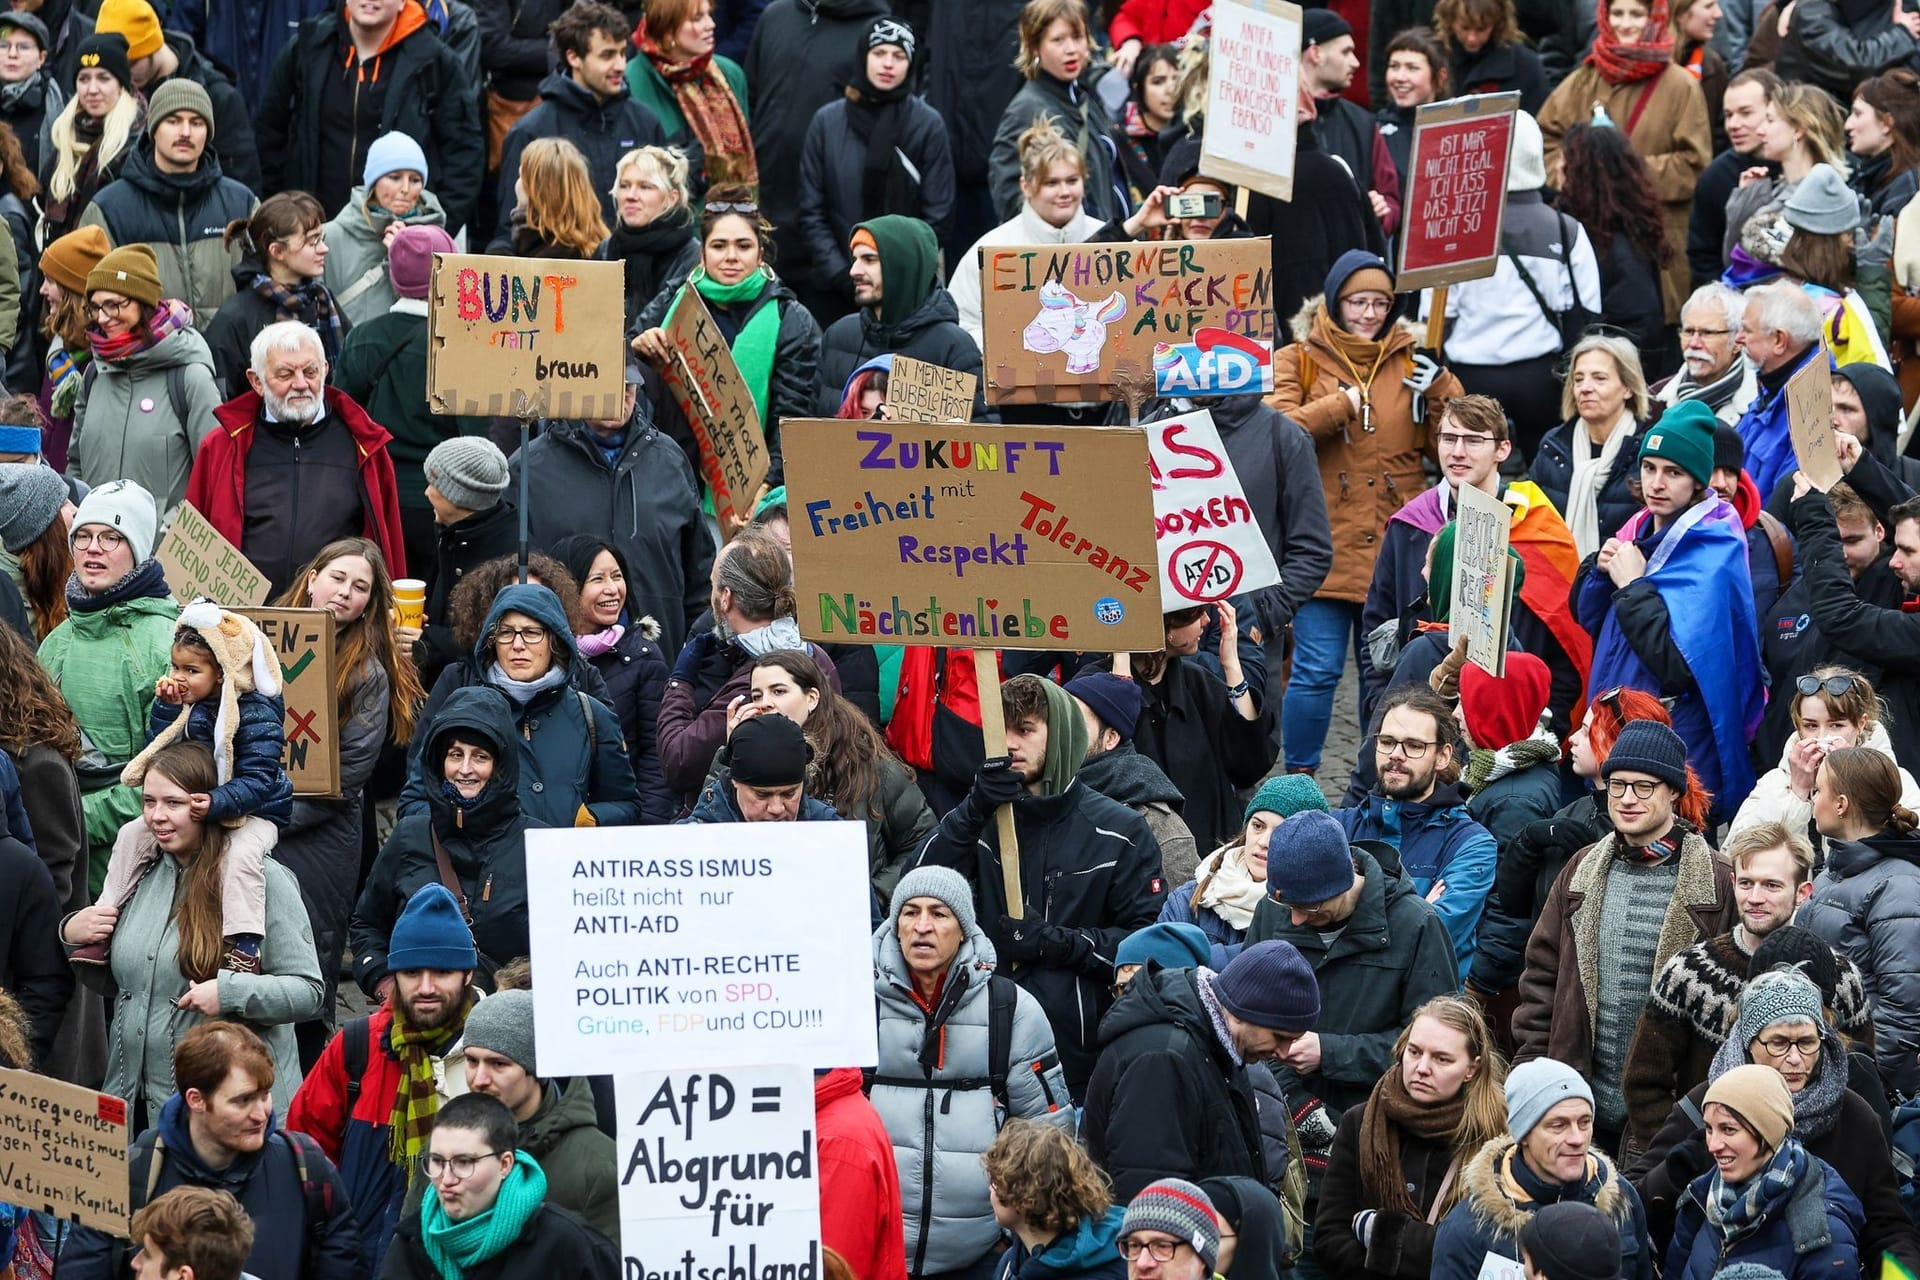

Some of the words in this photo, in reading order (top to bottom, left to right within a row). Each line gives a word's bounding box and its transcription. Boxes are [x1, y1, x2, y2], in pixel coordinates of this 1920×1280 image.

[1240, 22, 1274, 47] ANTIFA
[1219, 38, 1252, 63] MACHT
[1256, 49, 1292, 76] KINDER
[1261, 71, 1281, 93] UND
[1219, 80, 1288, 119] ERWACHSENE
[1231, 106, 1272, 136] EBENSO
[1440, 134, 1460, 156] IST
[1462, 130, 1487, 152] MIR
[1425, 155, 1459, 178] NICHT
[1430, 176, 1450, 198] ICH
[1453, 171, 1486, 195] LASS
[1423, 197, 1448, 220] DAS
[1451, 191, 1488, 216] JETZT
[1425, 216, 1459, 239] NICHT
[1463, 212, 1481, 234] SO
[992, 245, 1205, 292] EINHÖRNER
[456, 268, 578, 334] BUNT
[1135, 267, 1273, 310] KACKEN
[1133, 307, 1207, 336] AUF
[1225, 309, 1273, 338] DIE
[489, 330, 540, 351] STATT
[535, 355, 599, 381] braun
[1160, 351, 1252, 392] AfD
[857, 431, 1065, 476] ZUKUNFT
[1148, 424, 1225, 490] S
[940, 480, 976, 498] mit
[805, 486, 935, 537] Freiheit
[168, 533, 210, 584] TREND
[177, 506, 218, 552] NICHT
[216, 545, 260, 599] JEDER
[898, 533, 1028, 577] Respekt
[1019, 491, 1152, 593] Toleranz
[818, 592, 1069, 639] Nächstenliebe
[573, 888, 627, 907] heißt
[633, 887, 684, 906] nicht
[700, 890, 734, 906] nur
[573, 915, 680, 935] ANTI-AfD
[574, 960, 630, 979] Auch
[637, 954, 801, 977] ANTI-RECHTE
[576, 986, 670, 1006] POLITIK
[678, 989, 718, 1005] von
[724, 983, 780, 1004] SPD,
[576, 1015, 650, 1036] Grüne,
[753, 1009, 824, 1030] CDU!!!
[636, 1073, 736, 1141] AfD
[41, 1143, 102, 1179] Staat,
[620, 1130, 812, 1210] Abgrund
[75, 1185, 127, 1218] Kapital
[709, 1188, 774, 1237] für
[623, 1240, 818, 1280] Deutschland
